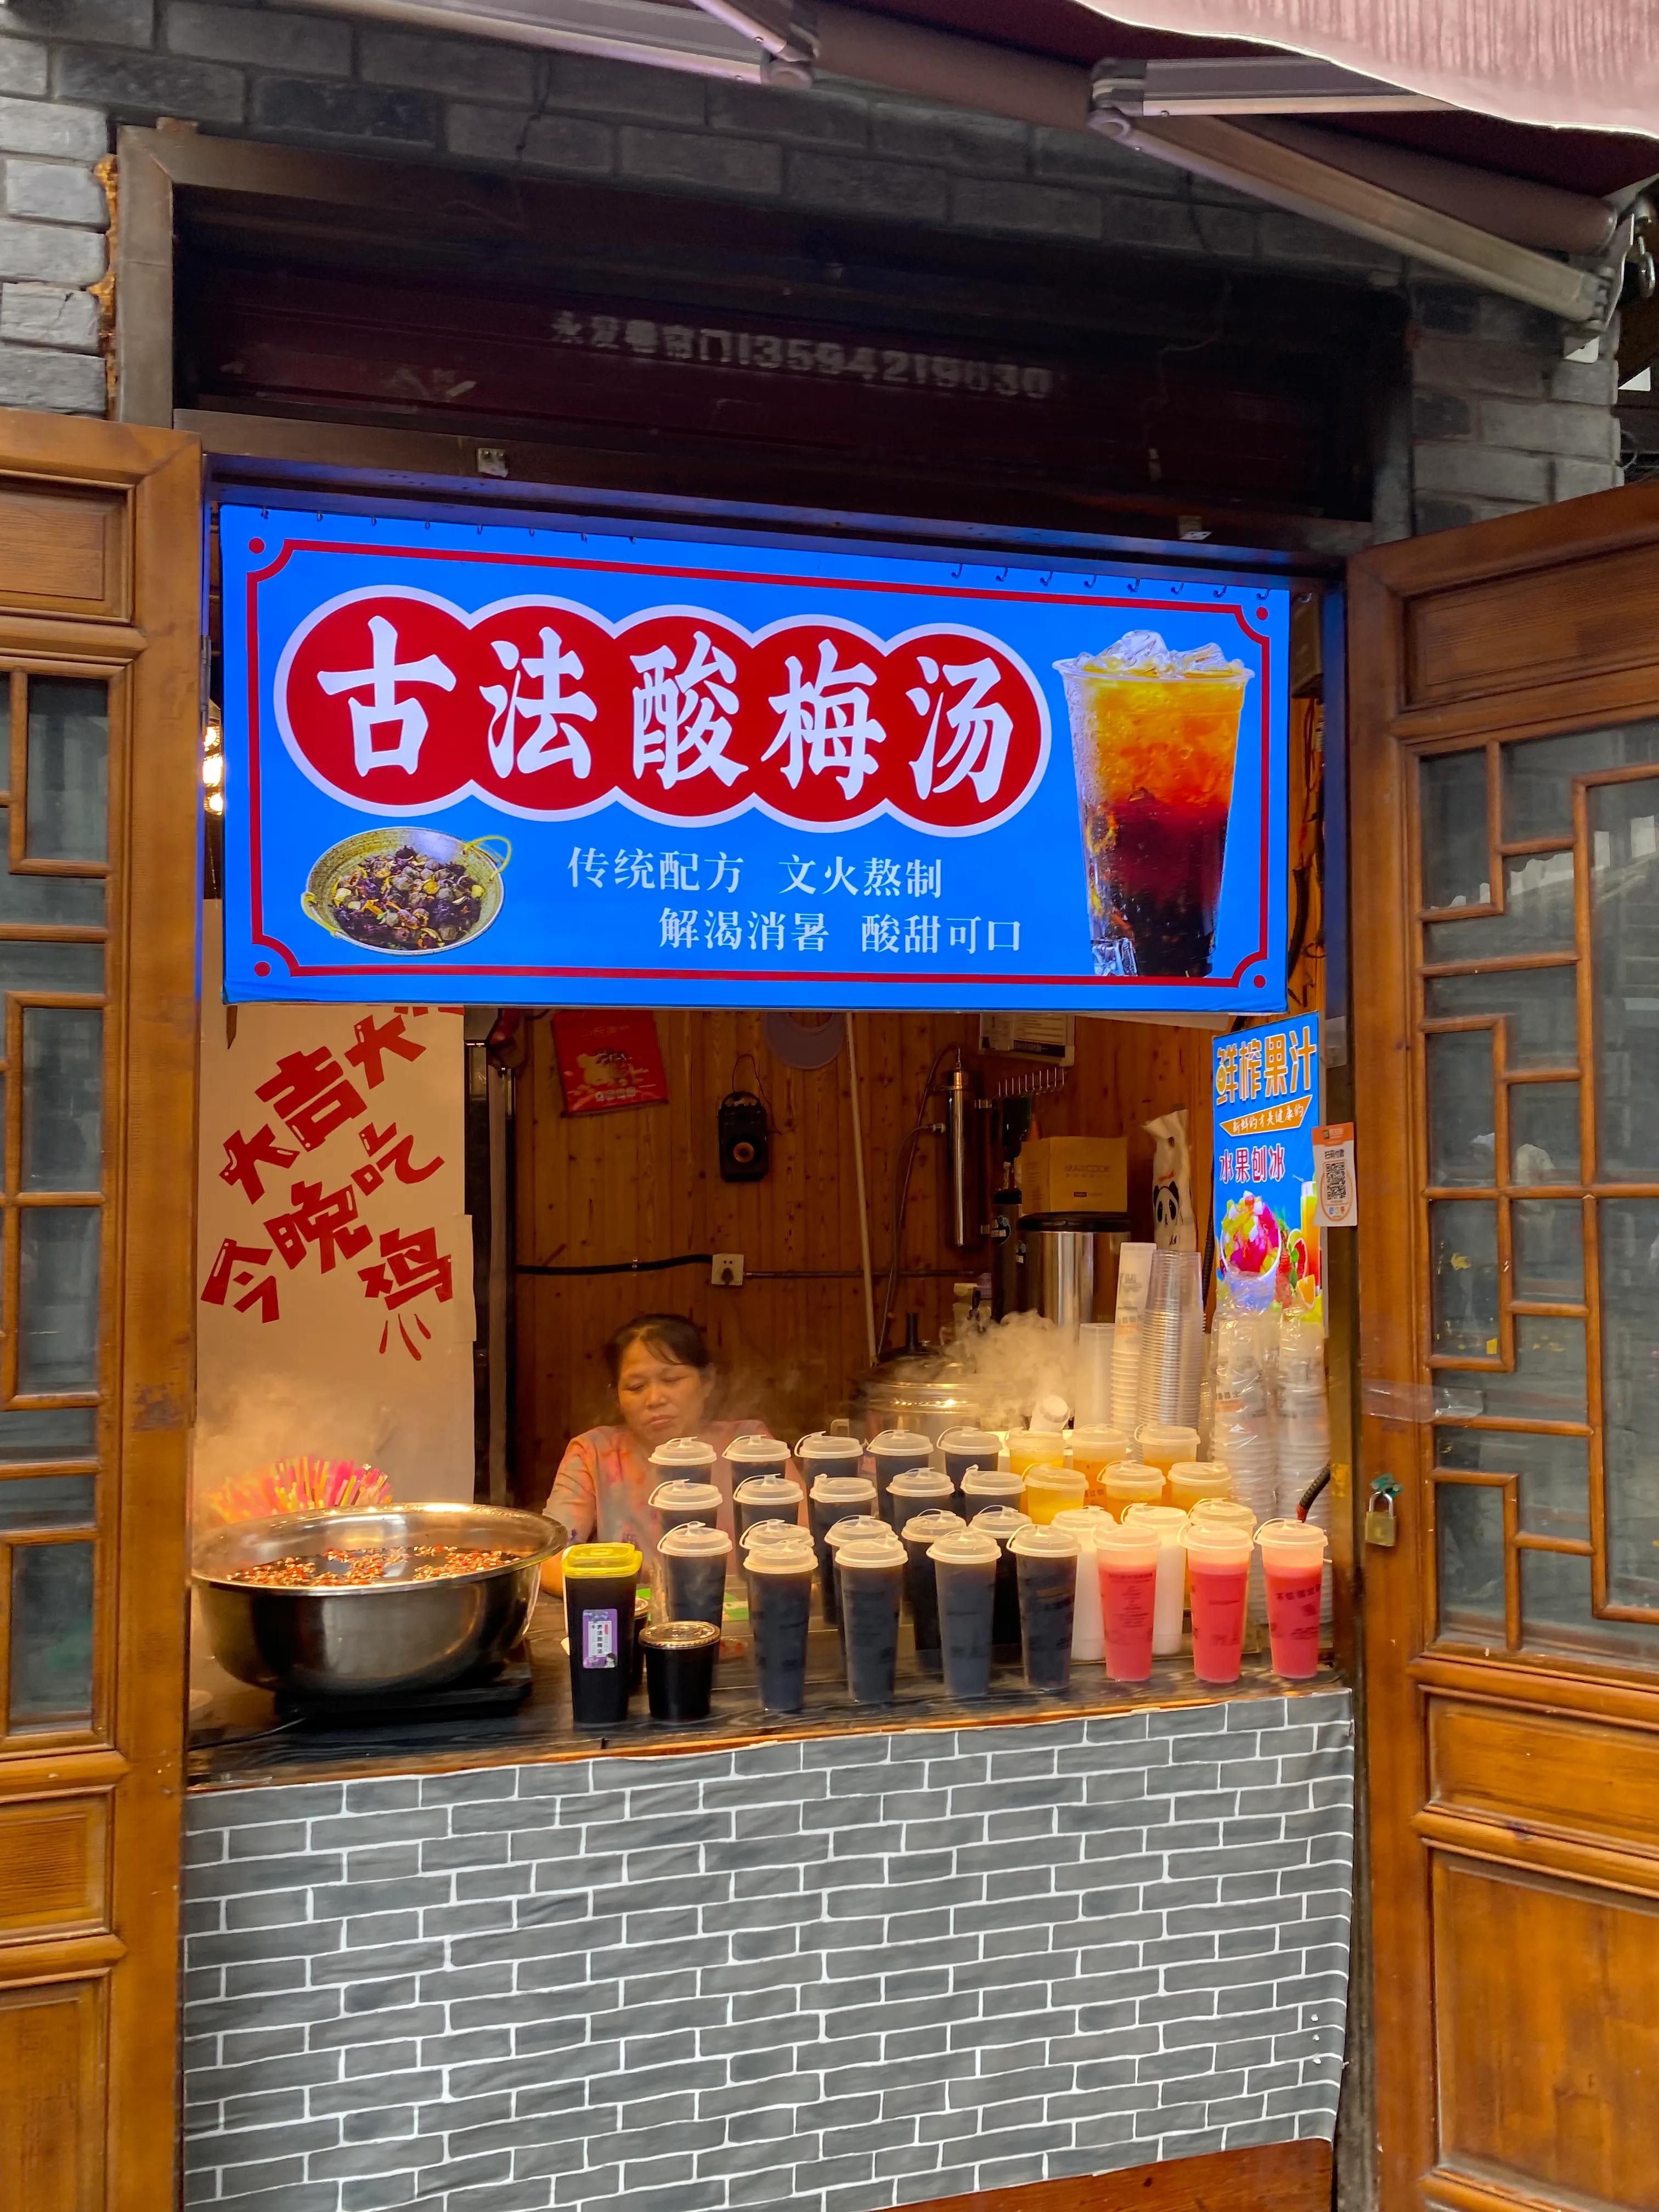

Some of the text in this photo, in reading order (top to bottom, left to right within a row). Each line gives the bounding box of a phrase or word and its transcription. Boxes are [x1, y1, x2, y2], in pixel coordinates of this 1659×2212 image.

[317, 615, 1015, 802] 古法酸梅汤
[567, 847, 942, 898] 传统配方 文火熬制
[658, 907, 1022, 954] 解渴消暑 酸甜可口
[1216, 1025, 1317, 1105] 鲜榨果汁
[219, 1006, 464, 1205] 大吉大
[1233, 1103, 1304, 1134] 新鲜的才是健康的
[1220, 1143, 1285, 1184] 水果刨冰
[201, 1122, 453, 1323] 今晚吃鸡
